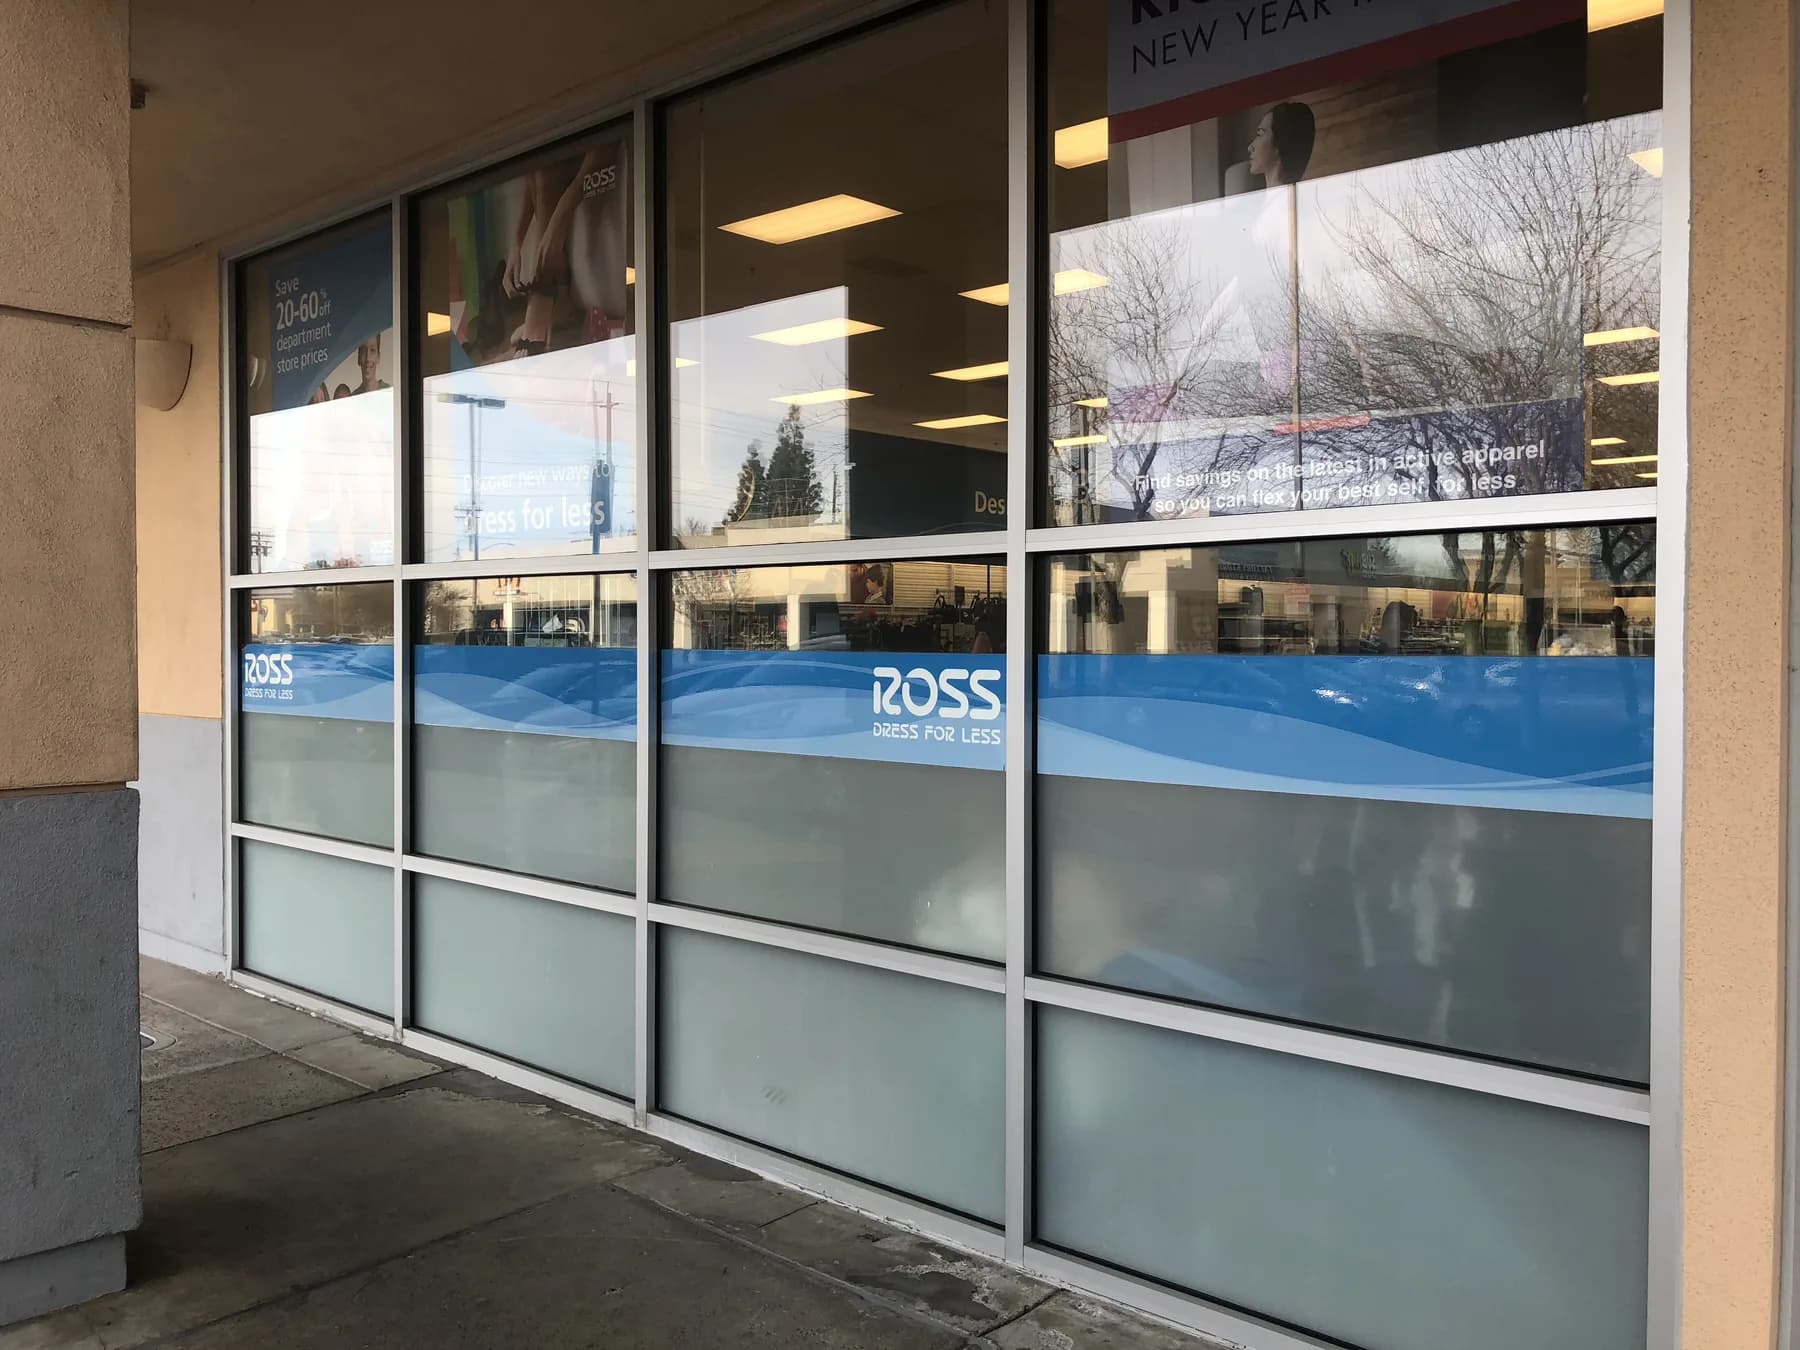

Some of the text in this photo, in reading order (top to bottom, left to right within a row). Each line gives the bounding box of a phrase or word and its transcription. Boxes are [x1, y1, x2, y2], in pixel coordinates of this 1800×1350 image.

[1133, 18, 1218, 74] NEW
[1236, 0, 1332, 41] YEAR
[583, 165, 617, 191] ROSS
[275, 277, 300, 297] Save
[276, 290, 319, 331] 20-60
[319, 300, 331, 316] off
[276, 322, 332, 353] department
[277, 347, 328, 374] store prices
[518, 470, 546, 487] new
[553, 463, 591, 486] ways
[594, 462, 610, 478] to
[1135, 439, 1545, 491] Find savings on the latest in active apparel
[975, 490, 1005, 515] Des
[1155, 500, 1177, 514] so
[1179, 496, 1210, 517] you
[1216, 493, 1246, 508] can
[1252, 489, 1285, 506] flex
[1290, 487, 1335, 507] your
[1338, 480, 1380, 500] best
[1436, 476, 1467, 494] for
[1472, 472, 1517, 490] less
[522, 498, 554, 530] for
[561, 496, 605, 528] less
[245, 653, 293, 685] ROSS
[245, 687, 293, 700] DRESS FOR LESS
[873, 667, 1001, 720] ROSS
[873, 722, 1001, 745] DRESS FOR LESS
